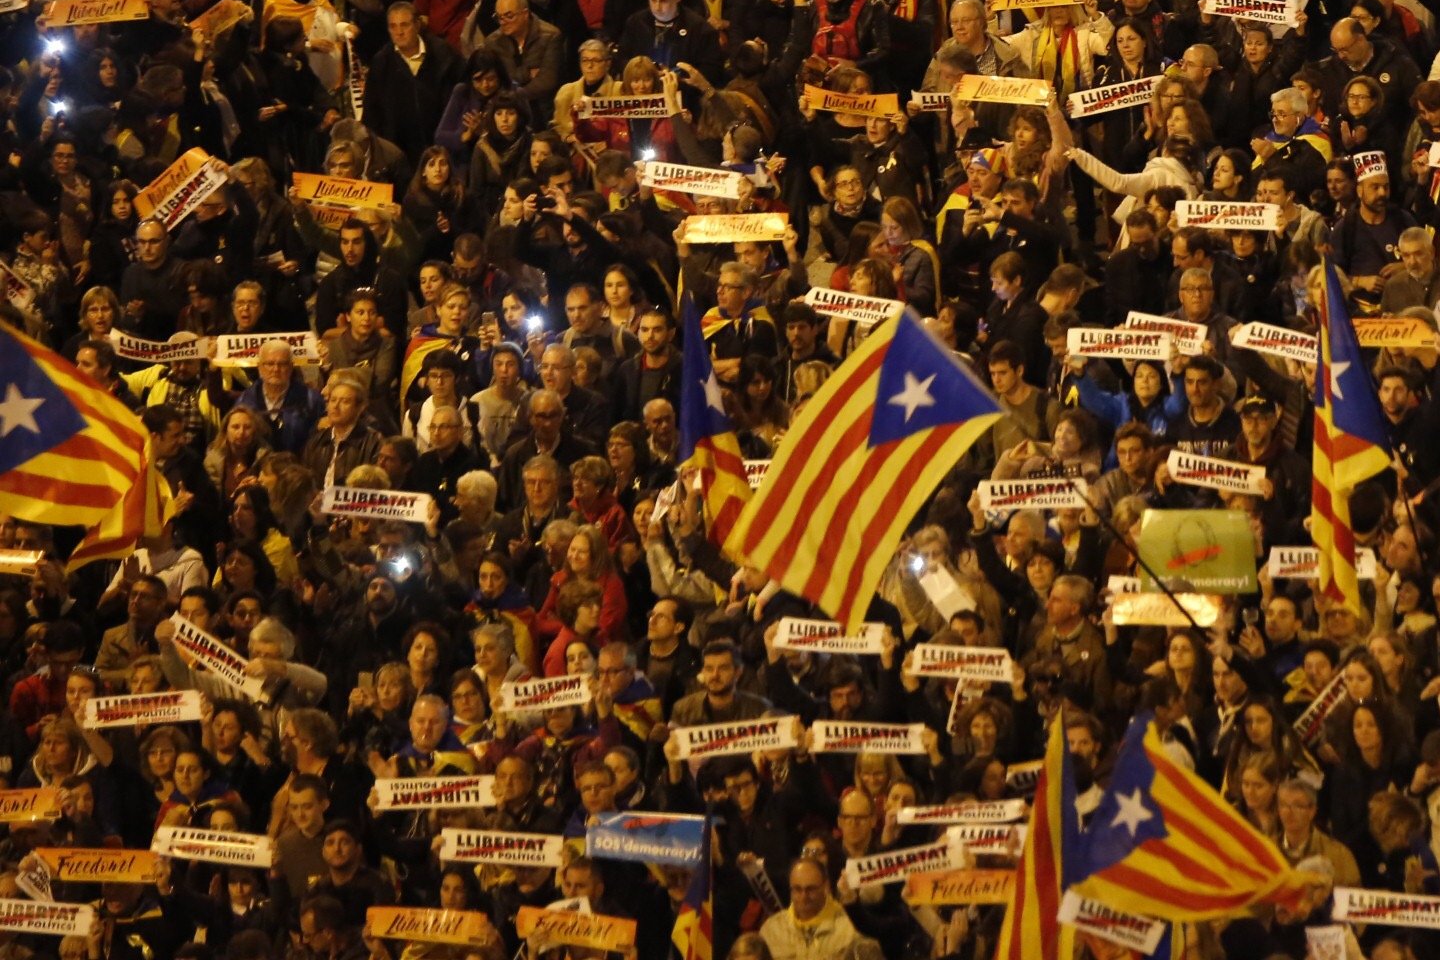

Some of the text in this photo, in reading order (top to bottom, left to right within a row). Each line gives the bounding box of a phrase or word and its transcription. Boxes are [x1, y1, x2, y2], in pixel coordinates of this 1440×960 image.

[1081, 82, 1153, 106] LLIBERTAT
[591, 99, 665, 111] LLIBERTAT
[655, 168, 729, 184] LLIBERTAT
[155, 171, 210, 224] LLIBERTAT
[1188, 205, 1266, 218] LLIBERTAT
[814, 292, 892, 314] LLIBERTAT
[1081, 333, 1162, 348] LLIBERTAT
[1177, 459, 1251, 482] LLIBERTAT
[990, 483, 1075, 497] LLIBERTAT
[335, 490, 417, 510] LLIBERTAT
[179, 626, 247, 676] LLIBERTAT
[922, 650, 1006, 667] LLIBERTAT
[514, 680, 581, 698] LLIBERTAT
[97, 696, 182, 713] LLIBERTAT
[689, 724, 778, 745] LLIBERTAT
[825, 727, 909, 741] LLIBERTAT
[458, 835, 545, 853] LLIBERTAT
[593, 838, 623, 852] SOS
[858, 847, 948, 873] LLIBERTAT
